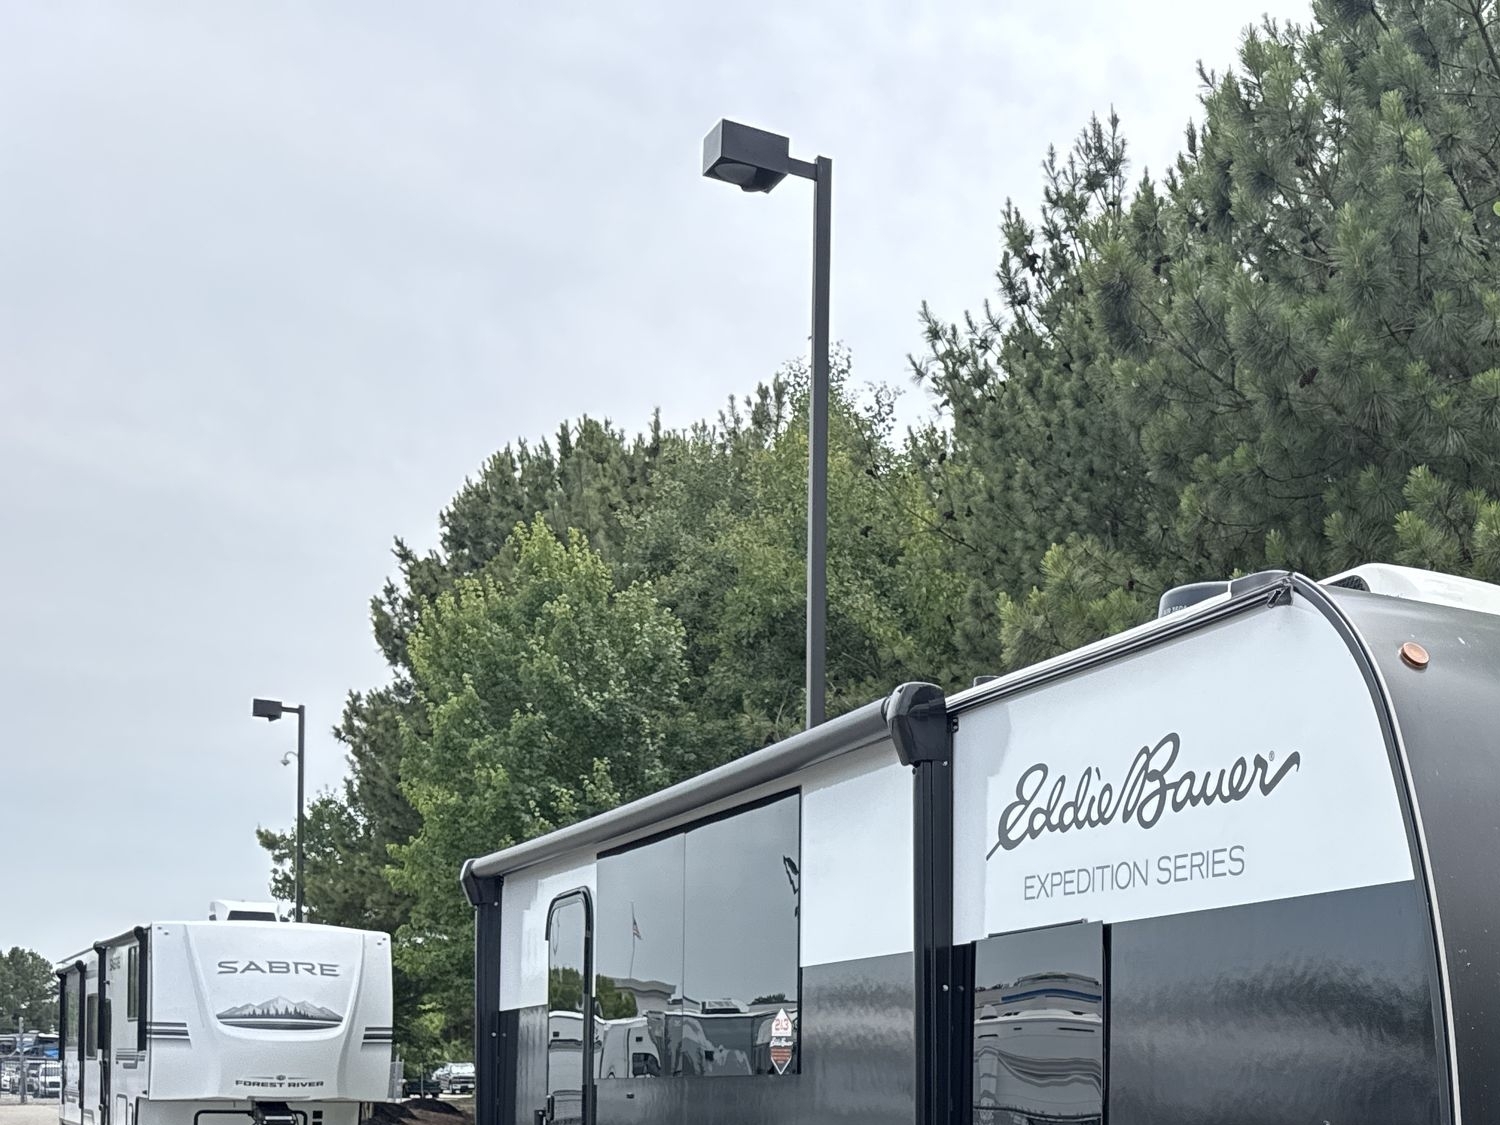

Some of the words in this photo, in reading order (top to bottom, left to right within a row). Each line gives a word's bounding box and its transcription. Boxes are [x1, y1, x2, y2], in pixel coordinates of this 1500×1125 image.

[1023, 858, 1150, 901] EXPEDITION
[1156, 844, 1246, 883] SERIES
[216, 959, 341, 978] SABRE
[235, 1079, 285, 1088] FOREST
[288, 1080, 324, 1088] RIVER
